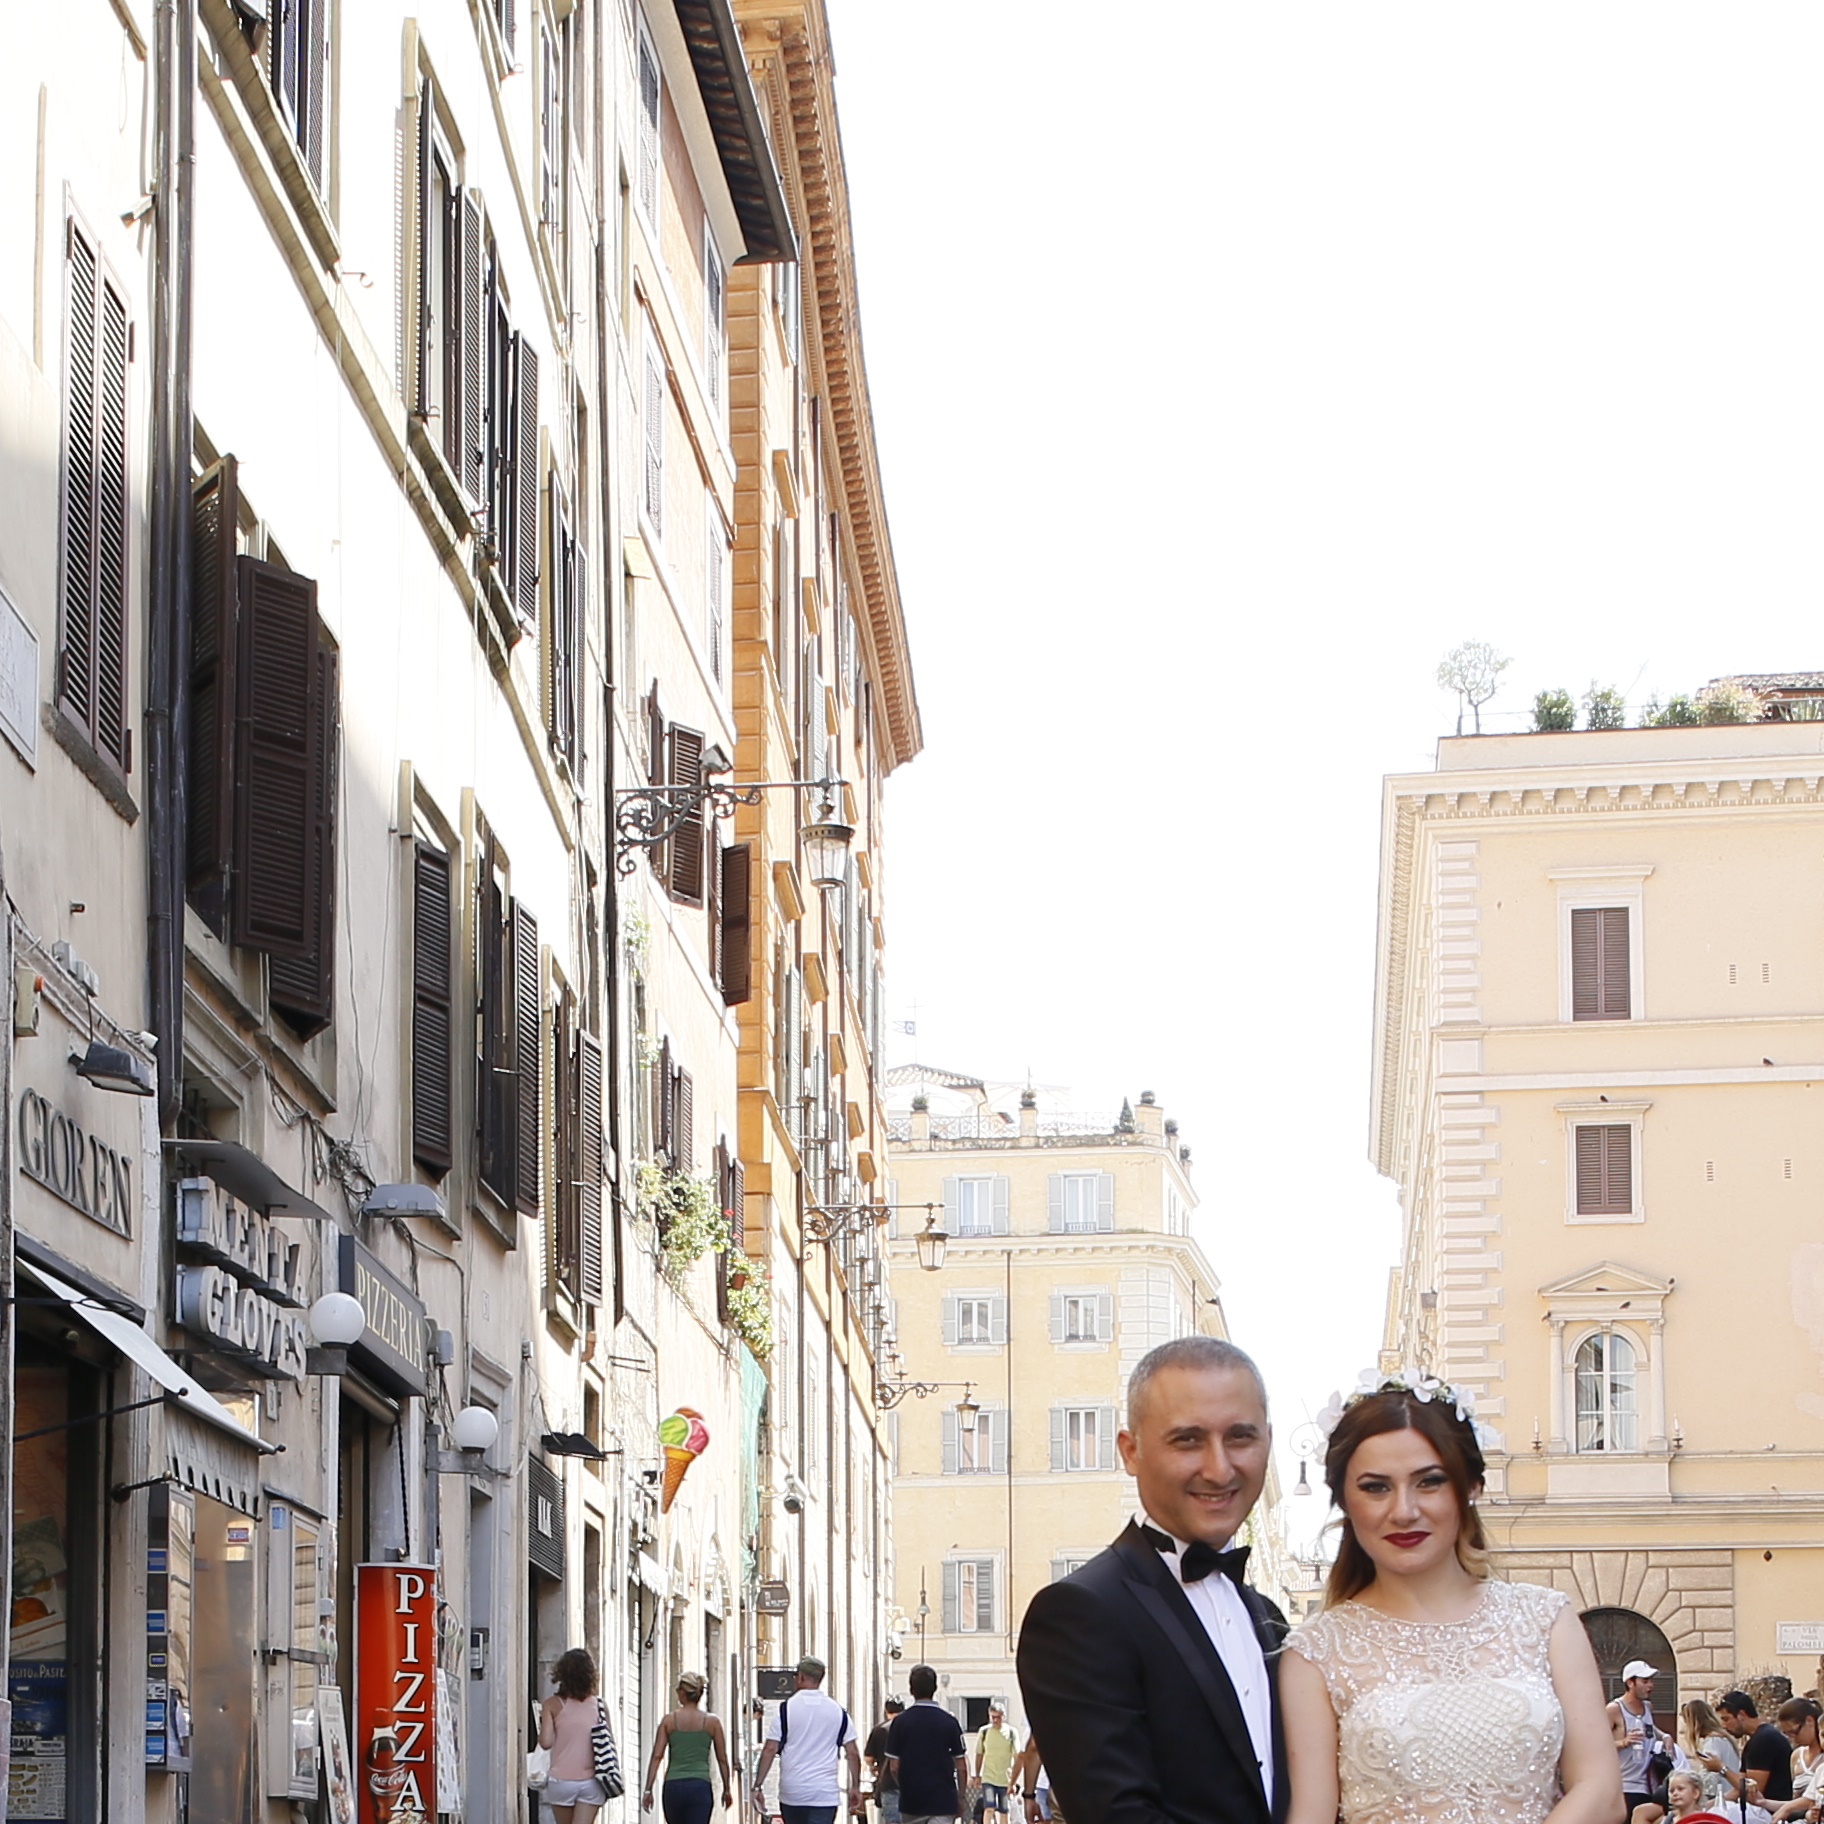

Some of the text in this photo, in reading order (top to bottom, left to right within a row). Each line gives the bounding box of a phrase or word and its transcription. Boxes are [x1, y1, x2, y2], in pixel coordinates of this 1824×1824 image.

[178, 1176, 311, 1309] MENTA
[178, 1264, 308, 1382] GLOVES
[356, 1261, 425, 1373] PIZZERIA
[391, 1573, 426, 1812] PIZZA
